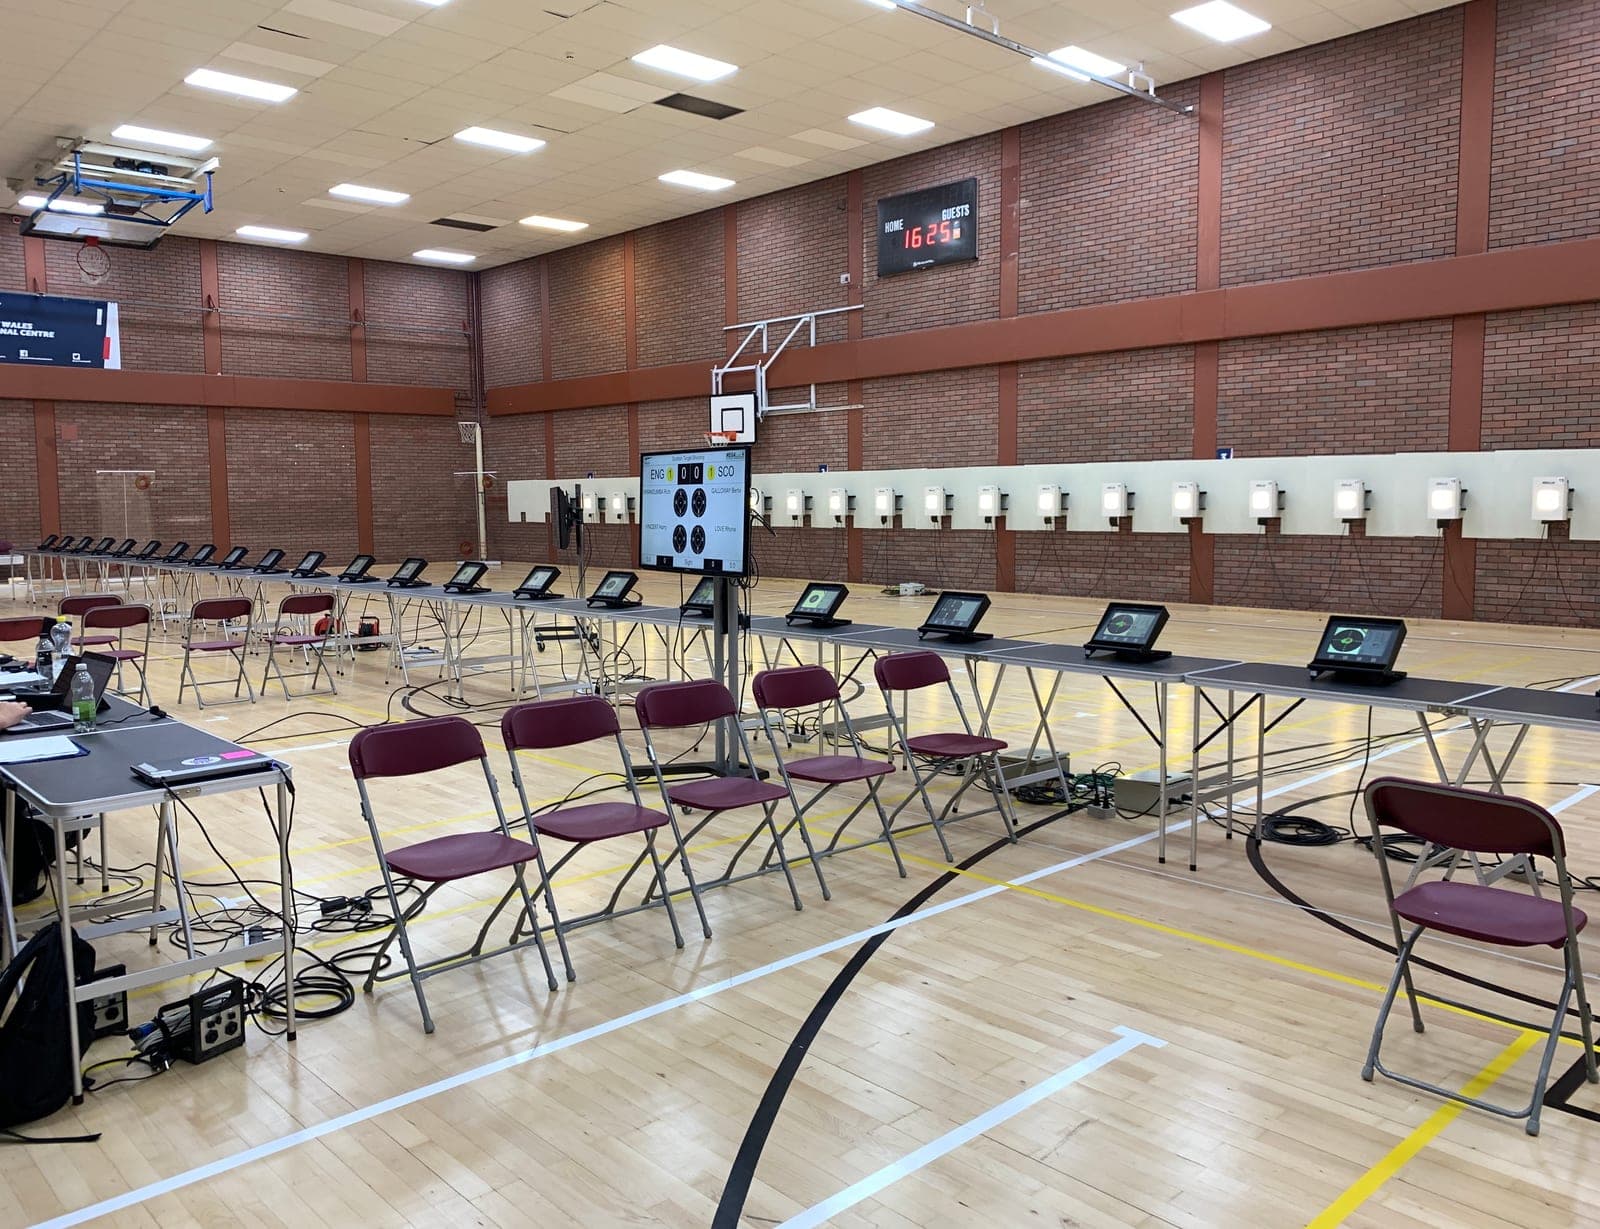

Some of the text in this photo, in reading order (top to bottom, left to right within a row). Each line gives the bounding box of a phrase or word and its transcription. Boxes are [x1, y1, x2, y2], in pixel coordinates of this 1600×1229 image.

[942, 204, 970, 221] GUESTS
[885, 219, 904, 233] HOME
[1, 321, 33, 330] WALES
[20, 330, 55, 338] CENTRE
[650, 469, 665, 480] ENG
[681, 466, 687, 480] 0
[693, 466, 700, 479] 0
[718, 465, 735, 478] SCO
